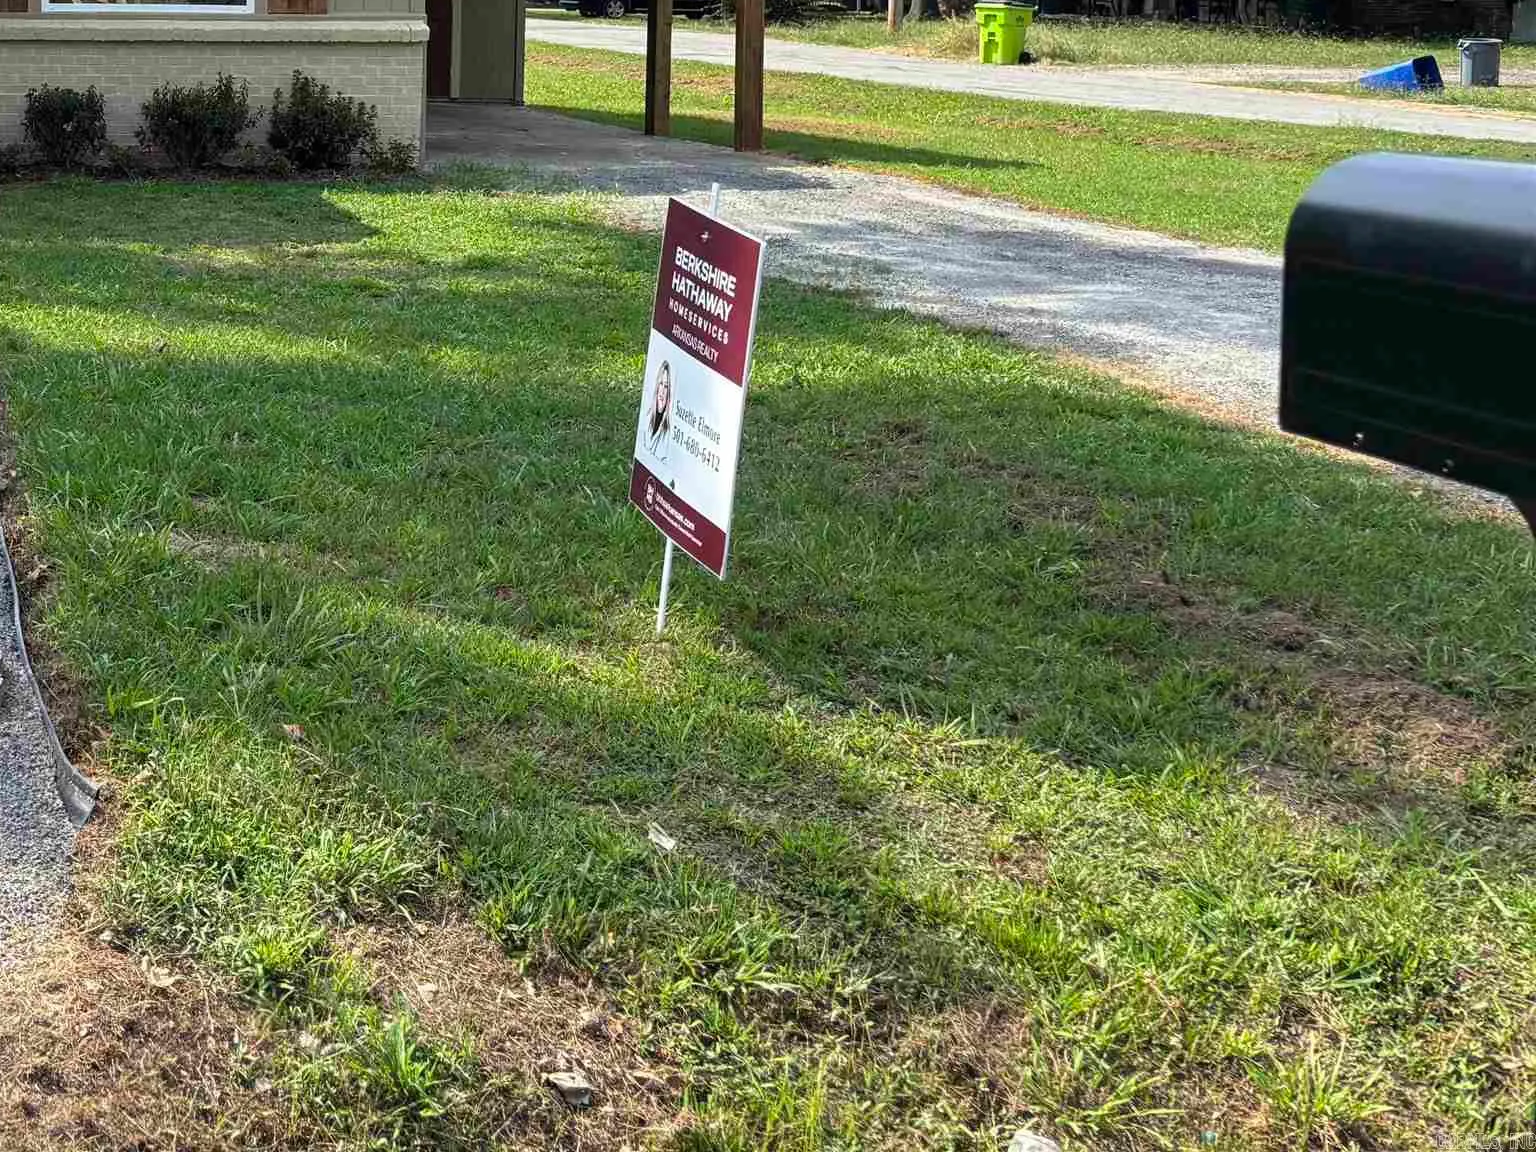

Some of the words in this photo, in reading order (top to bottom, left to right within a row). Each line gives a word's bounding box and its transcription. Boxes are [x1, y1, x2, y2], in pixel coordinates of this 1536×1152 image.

[675, 246, 737, 298] BERKSHIRE
[668, 298, 729, 345] HOMESERVICES
[671, 271, 733, 323] HATHAWAY
[697, 339, 719, 364] REALTY
